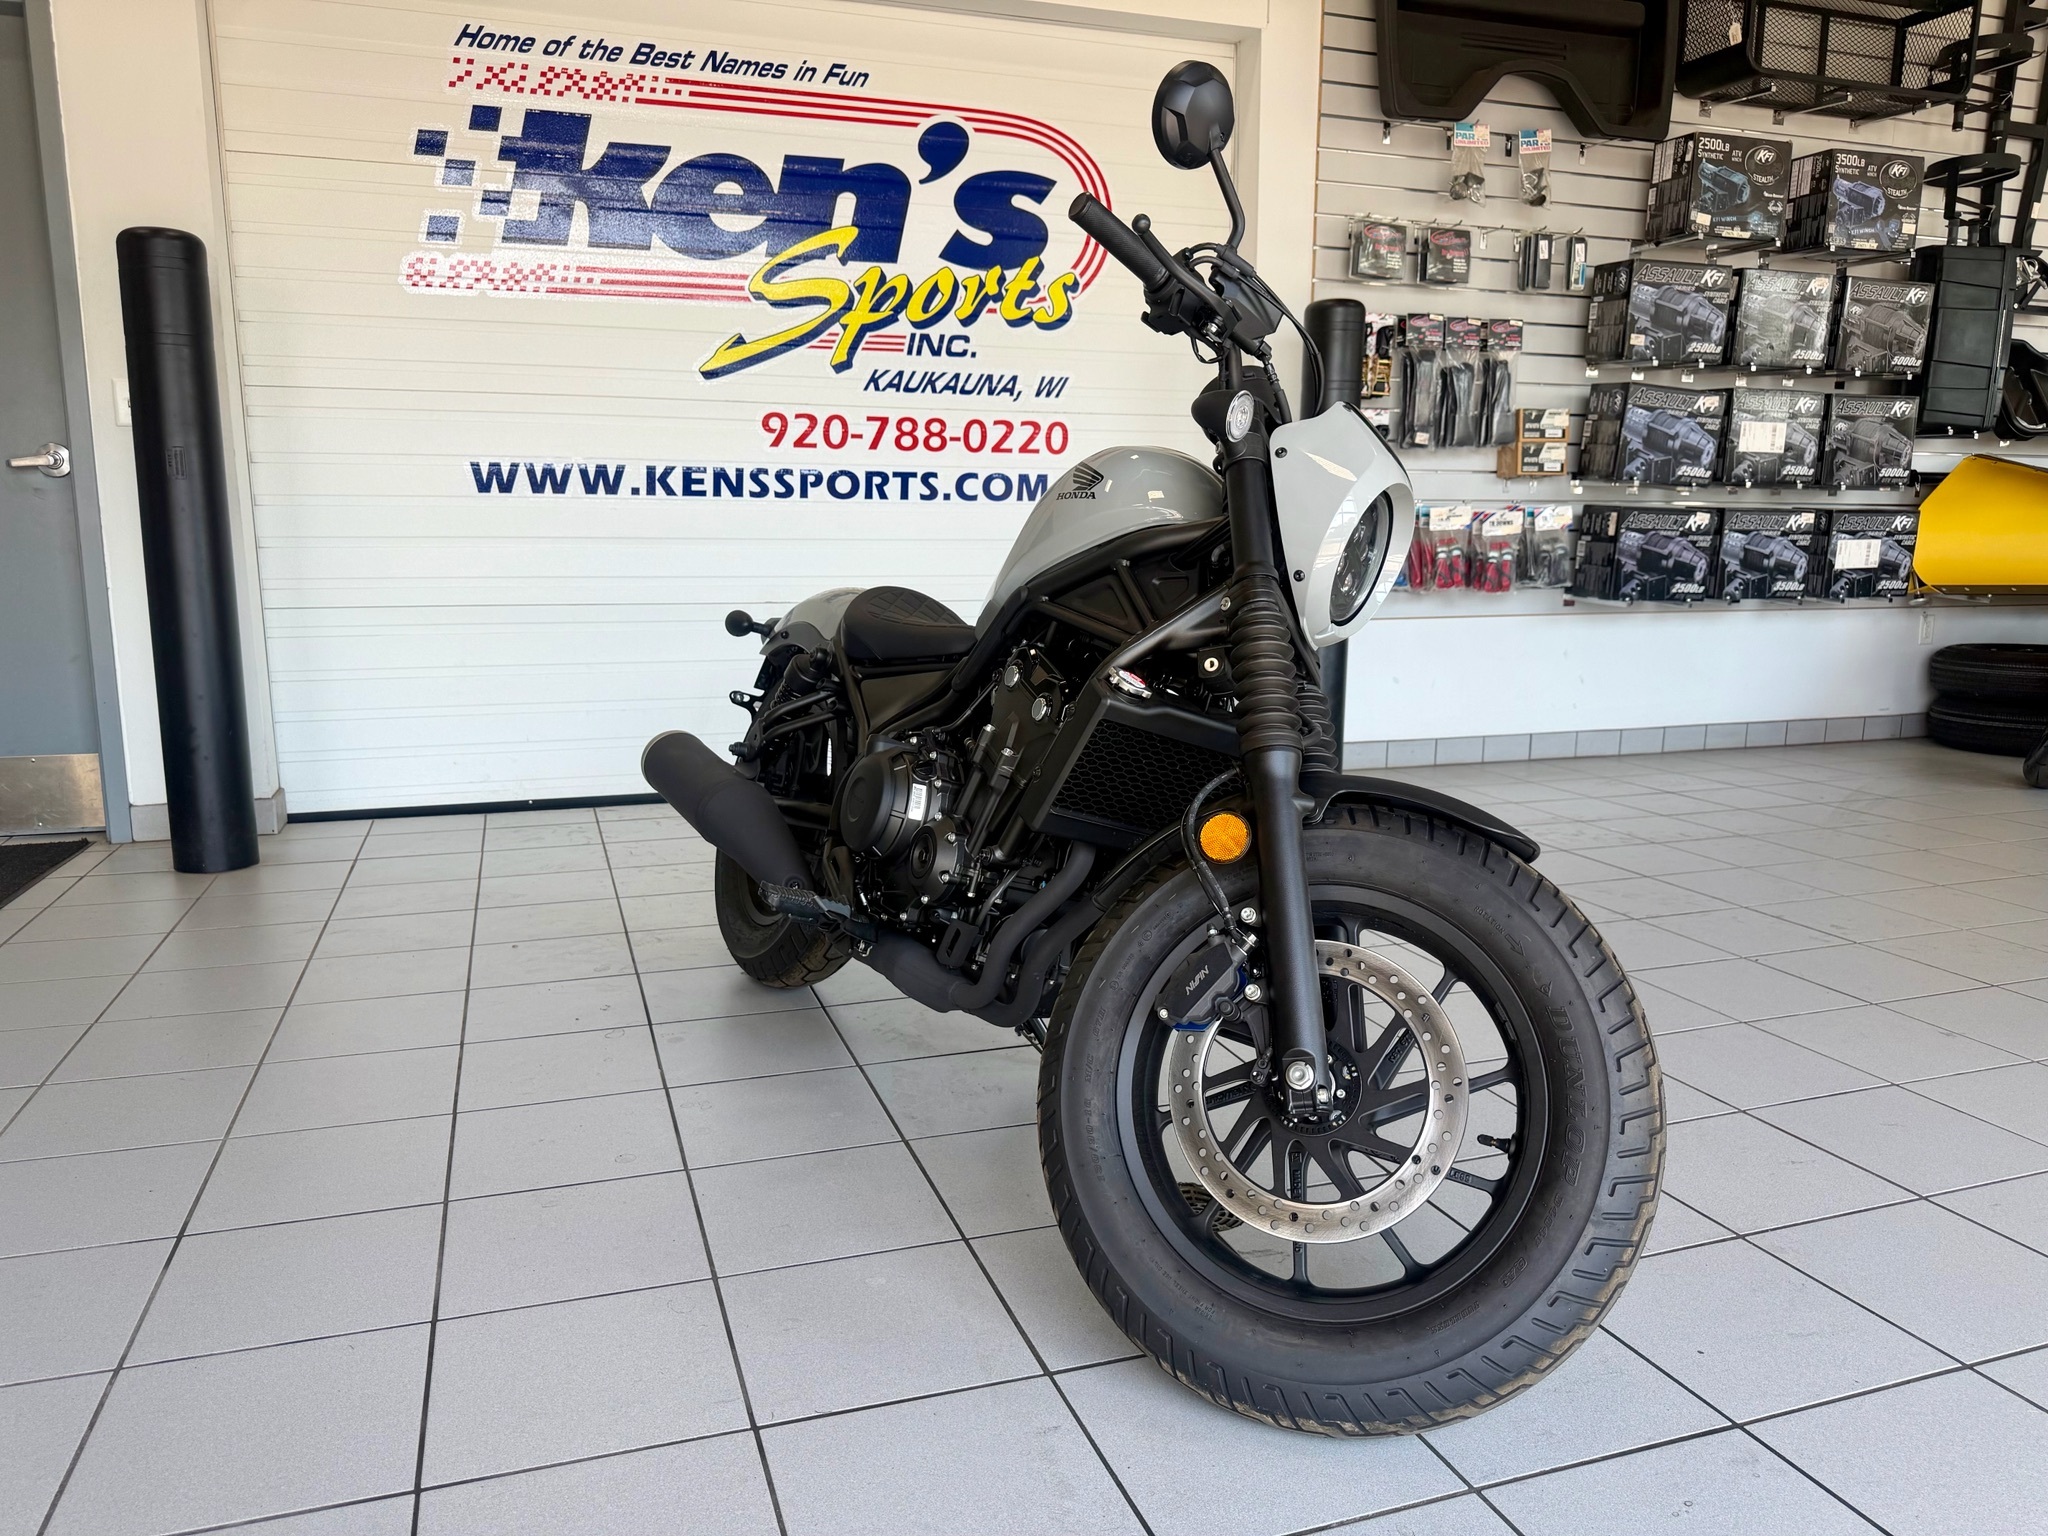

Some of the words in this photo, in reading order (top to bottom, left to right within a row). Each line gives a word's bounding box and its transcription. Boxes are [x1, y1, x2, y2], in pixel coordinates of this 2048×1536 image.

[454, 24, 535, 54] Home
[542, 36, 577, 58] of
[580, 40, 623, 64] the
[630, 44, 696, 71] Best
[702, 50, 789, 80] Names
[794, 60, 817, 82] in
[822, 63, 869, 89] Fun
[1698, 137, 1730, 151] 2500LB
[1835, 154, 1866, 167] 3500LB
[1753, 173, 1774, 183] STEALTH
[1887, 187, 1907, 196] STEALTH
[1634, 263, 1703, 285] ASSAULT
[1743, 273, 1808, 293] ASSAULT
[1849, 281, 1908, 301] ASSAULT
[700, 227, 1078, 381] Sports
[906, 333, 977, 358] INC.
[1688, 342, 1723, 353] 2500LB
[1792, 349, 1824, 360] 2500LB
[1891, 356, 1922, 366] 5000LB
[863, 368, 1024, 402] KAUKAUNA,
[1034, 376, 1070, 399] WI
[1628, 387, 1697, 410] ASSAULT
[1833, 398, 1894, 416] ASSAULT
[761, 411, 1069, 455] 920-788-0220
[1677, 466, 1712, 478] 2500LB
[1783, 465, 1814, 475] 2500LB
[1879, 467, 1910, 478] 5000LB
[469, 461, 1049, 502] WWW.KENSSPORTS.COM
[1056, 491, 1096, 501] HONDA
[1621, 511, 1689, 529] ASSAULT
[1725, 512, 1789, 530] ASSAULT
[1833, 514, 1895, 530] ASSAULT
[1671, 582, 1705, 593] 2500LB
[1878, 580, 1908, 590] 2500LB
[1473, 905, 1506, 935] ROTATION
[1547, 1005, 1588, 1187] DUNLOP
